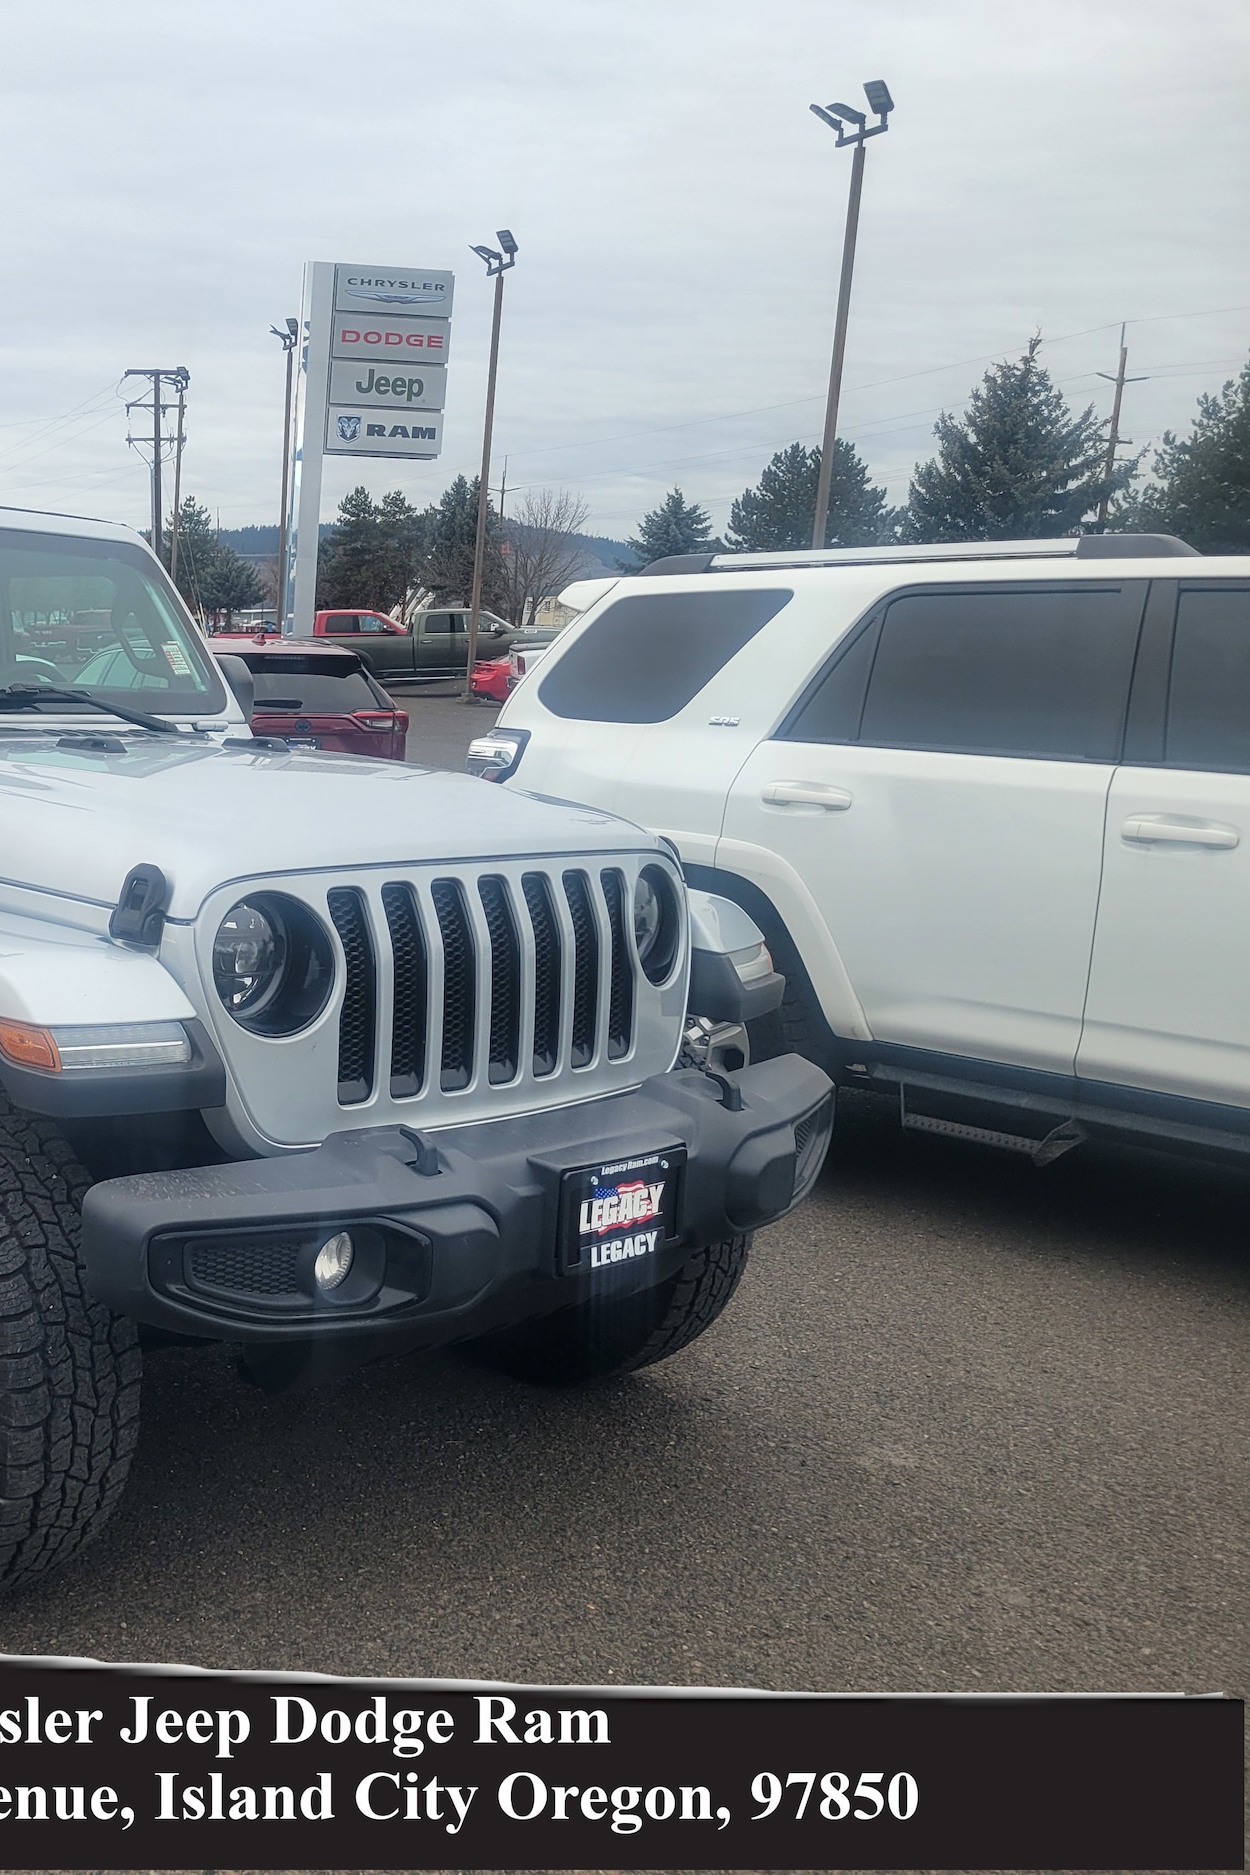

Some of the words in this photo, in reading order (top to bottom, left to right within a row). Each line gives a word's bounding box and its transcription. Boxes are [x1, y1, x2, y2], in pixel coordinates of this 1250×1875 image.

[347, 277, 446, 292] CHRYSLER
[341, 329, 443, 349] DODGE
[356, 368, 424, 402] Jeep
[366, 424, 437, 440] RAM
[709, 715, 740, 727] SR5
[579, 1184, 664, 1233] LEGACY
[591, 1231, 658, 1268] LEGACY
